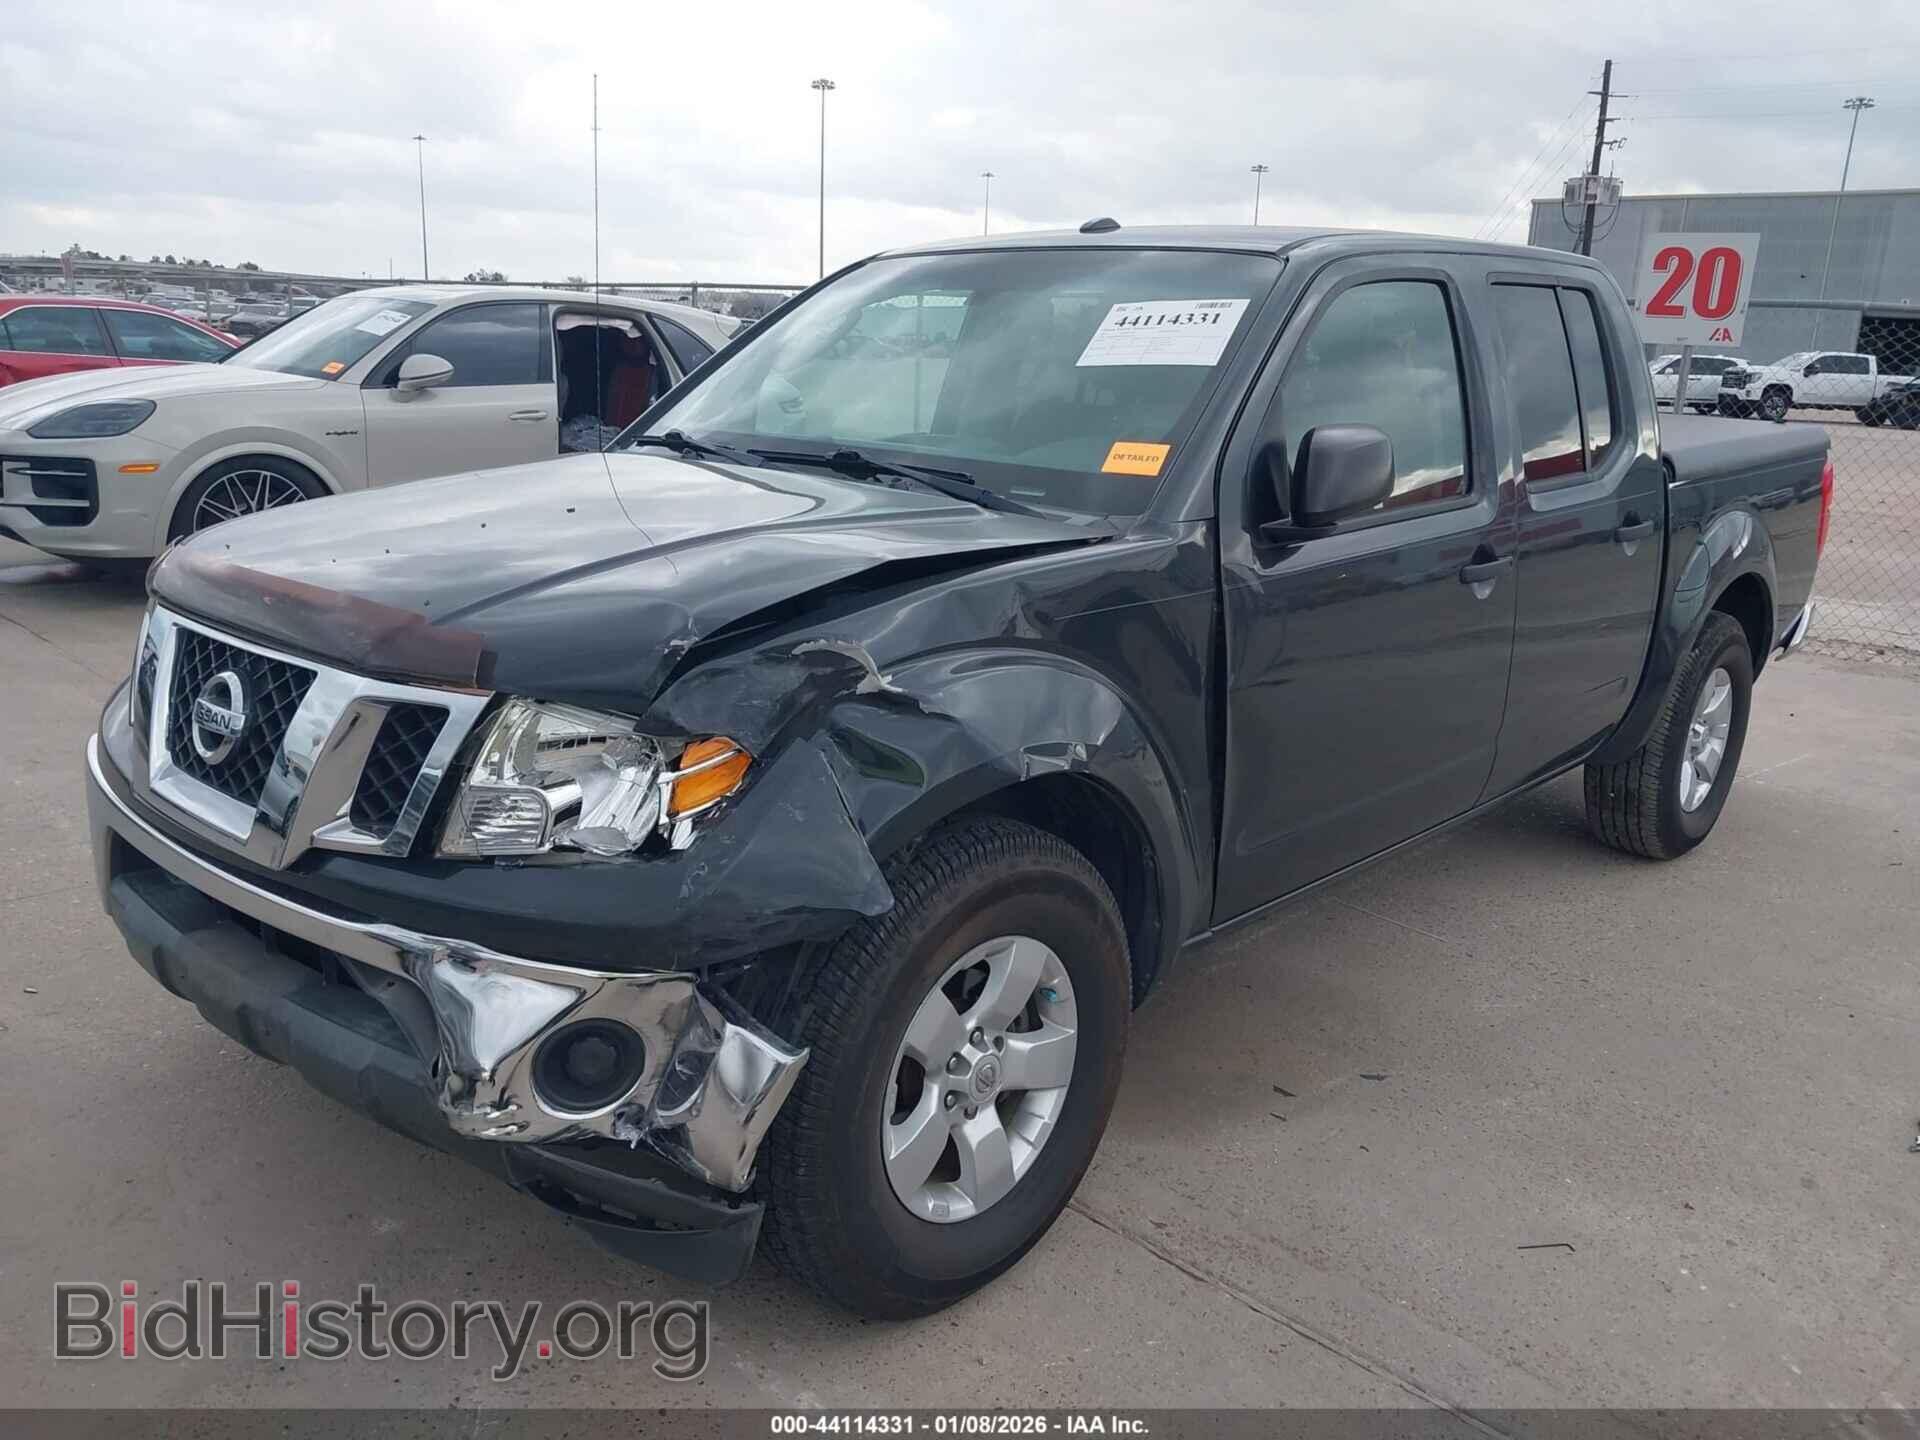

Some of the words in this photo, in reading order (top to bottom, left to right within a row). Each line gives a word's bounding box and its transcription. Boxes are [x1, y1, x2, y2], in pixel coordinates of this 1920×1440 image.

[1646, 246, 1743, 320] 20
[1114, 313, 1221, 327] 44114331
[1112, 453, 1160, 463] DETAILED
[196, 700, 232, 730] SSAN
